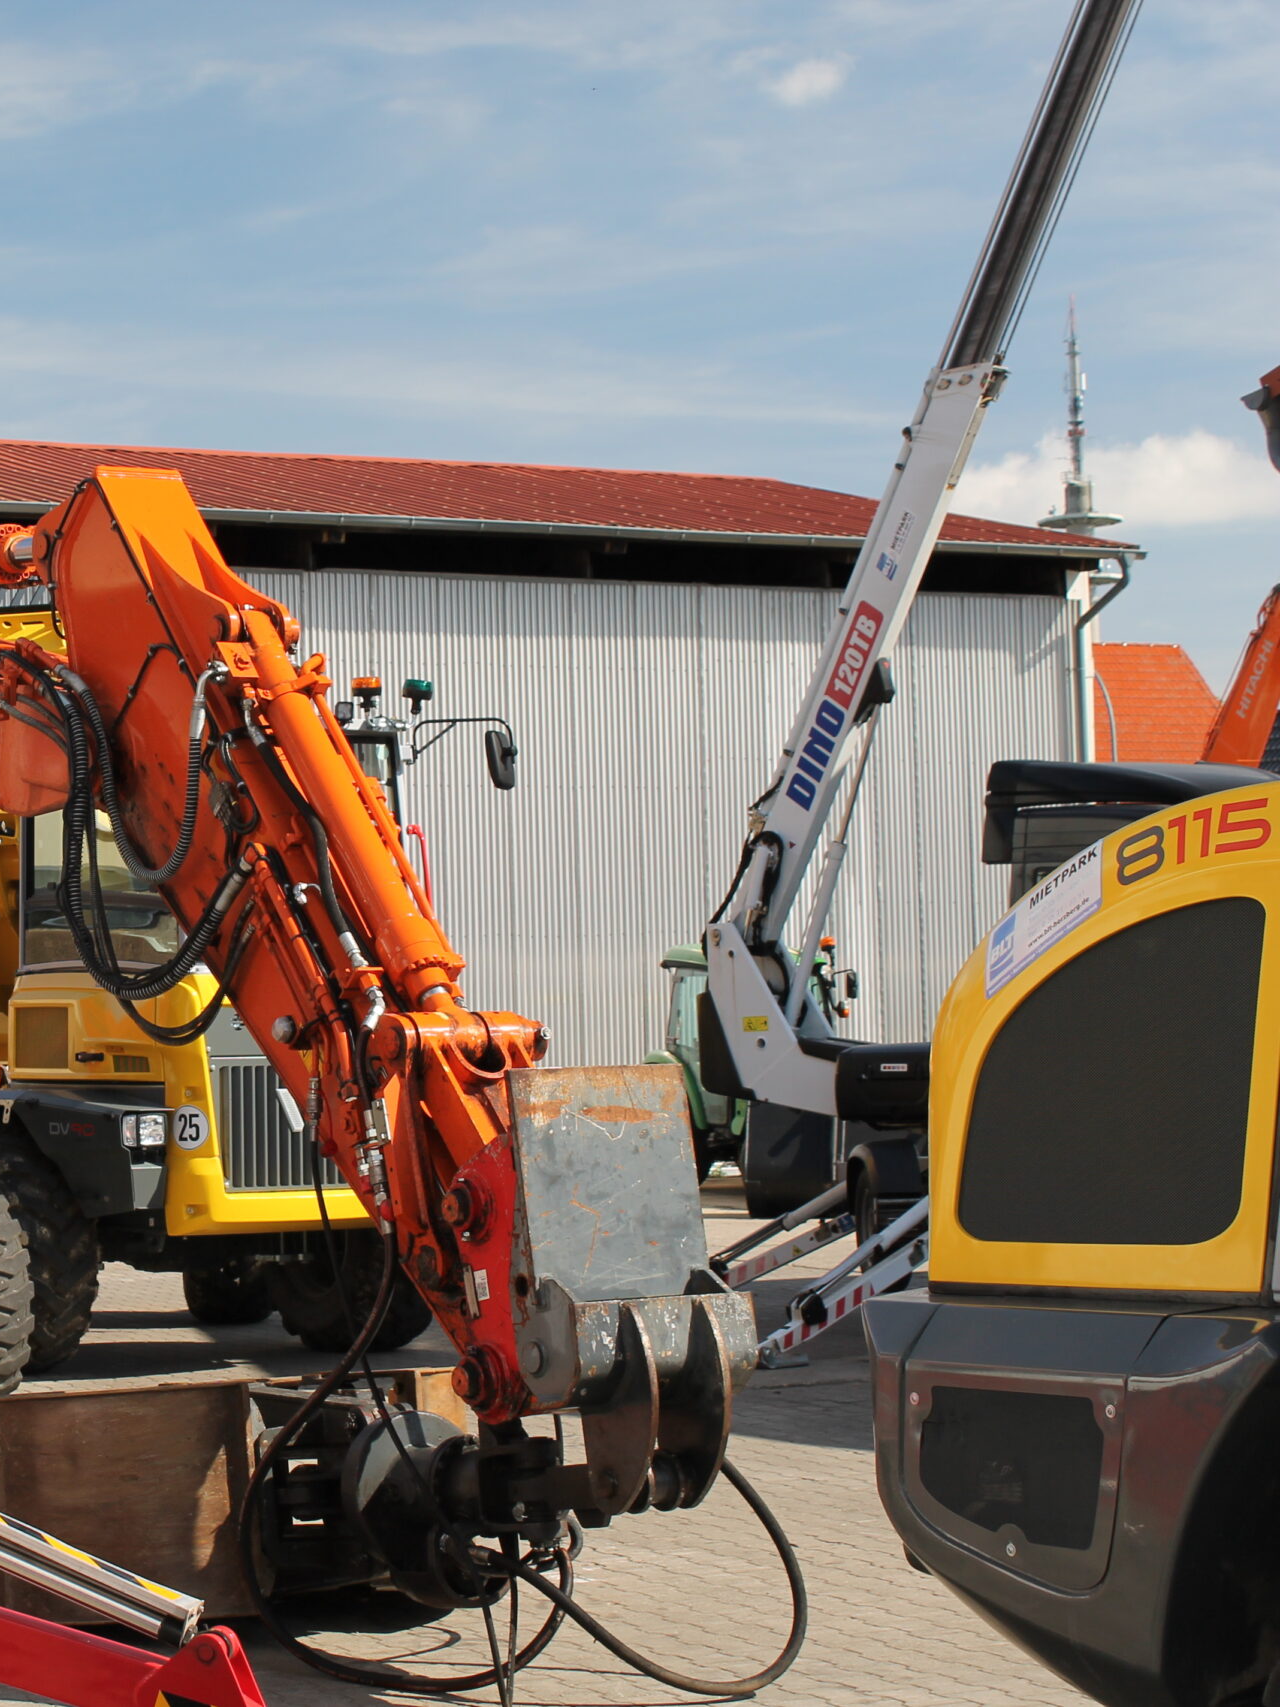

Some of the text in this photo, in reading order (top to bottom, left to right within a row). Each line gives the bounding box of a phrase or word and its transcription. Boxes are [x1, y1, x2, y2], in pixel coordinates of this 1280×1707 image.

[1235, 639, 1276, 719] HITACHI
[785, 614, 878, 812] DINO 120TB
[1116, 797, 1272, 886] 8115
[1028, 846, 1099, 910] MIETPARK
[991, 932, 1016, 963] BLT
[48, 1121, 97, 1137] DV90
[177, 1113, 201, 1143] 25
